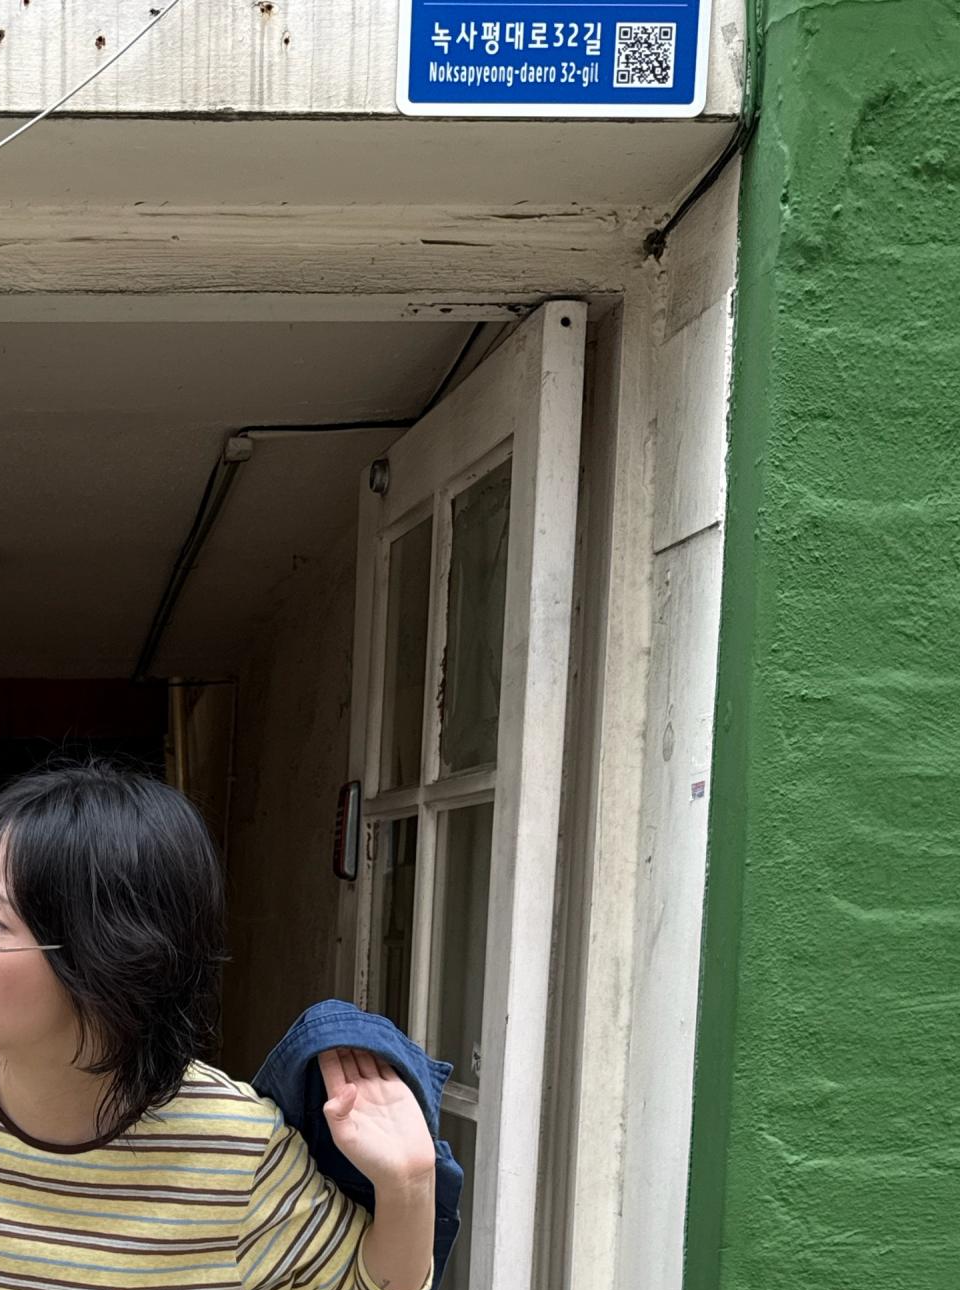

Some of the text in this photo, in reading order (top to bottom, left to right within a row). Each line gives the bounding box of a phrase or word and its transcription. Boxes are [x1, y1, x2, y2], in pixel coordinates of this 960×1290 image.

[431, 21, 603, 57] 녹사평대로32길
[429, 61, 599, 87] Noksapyeong-daero 32-gil
